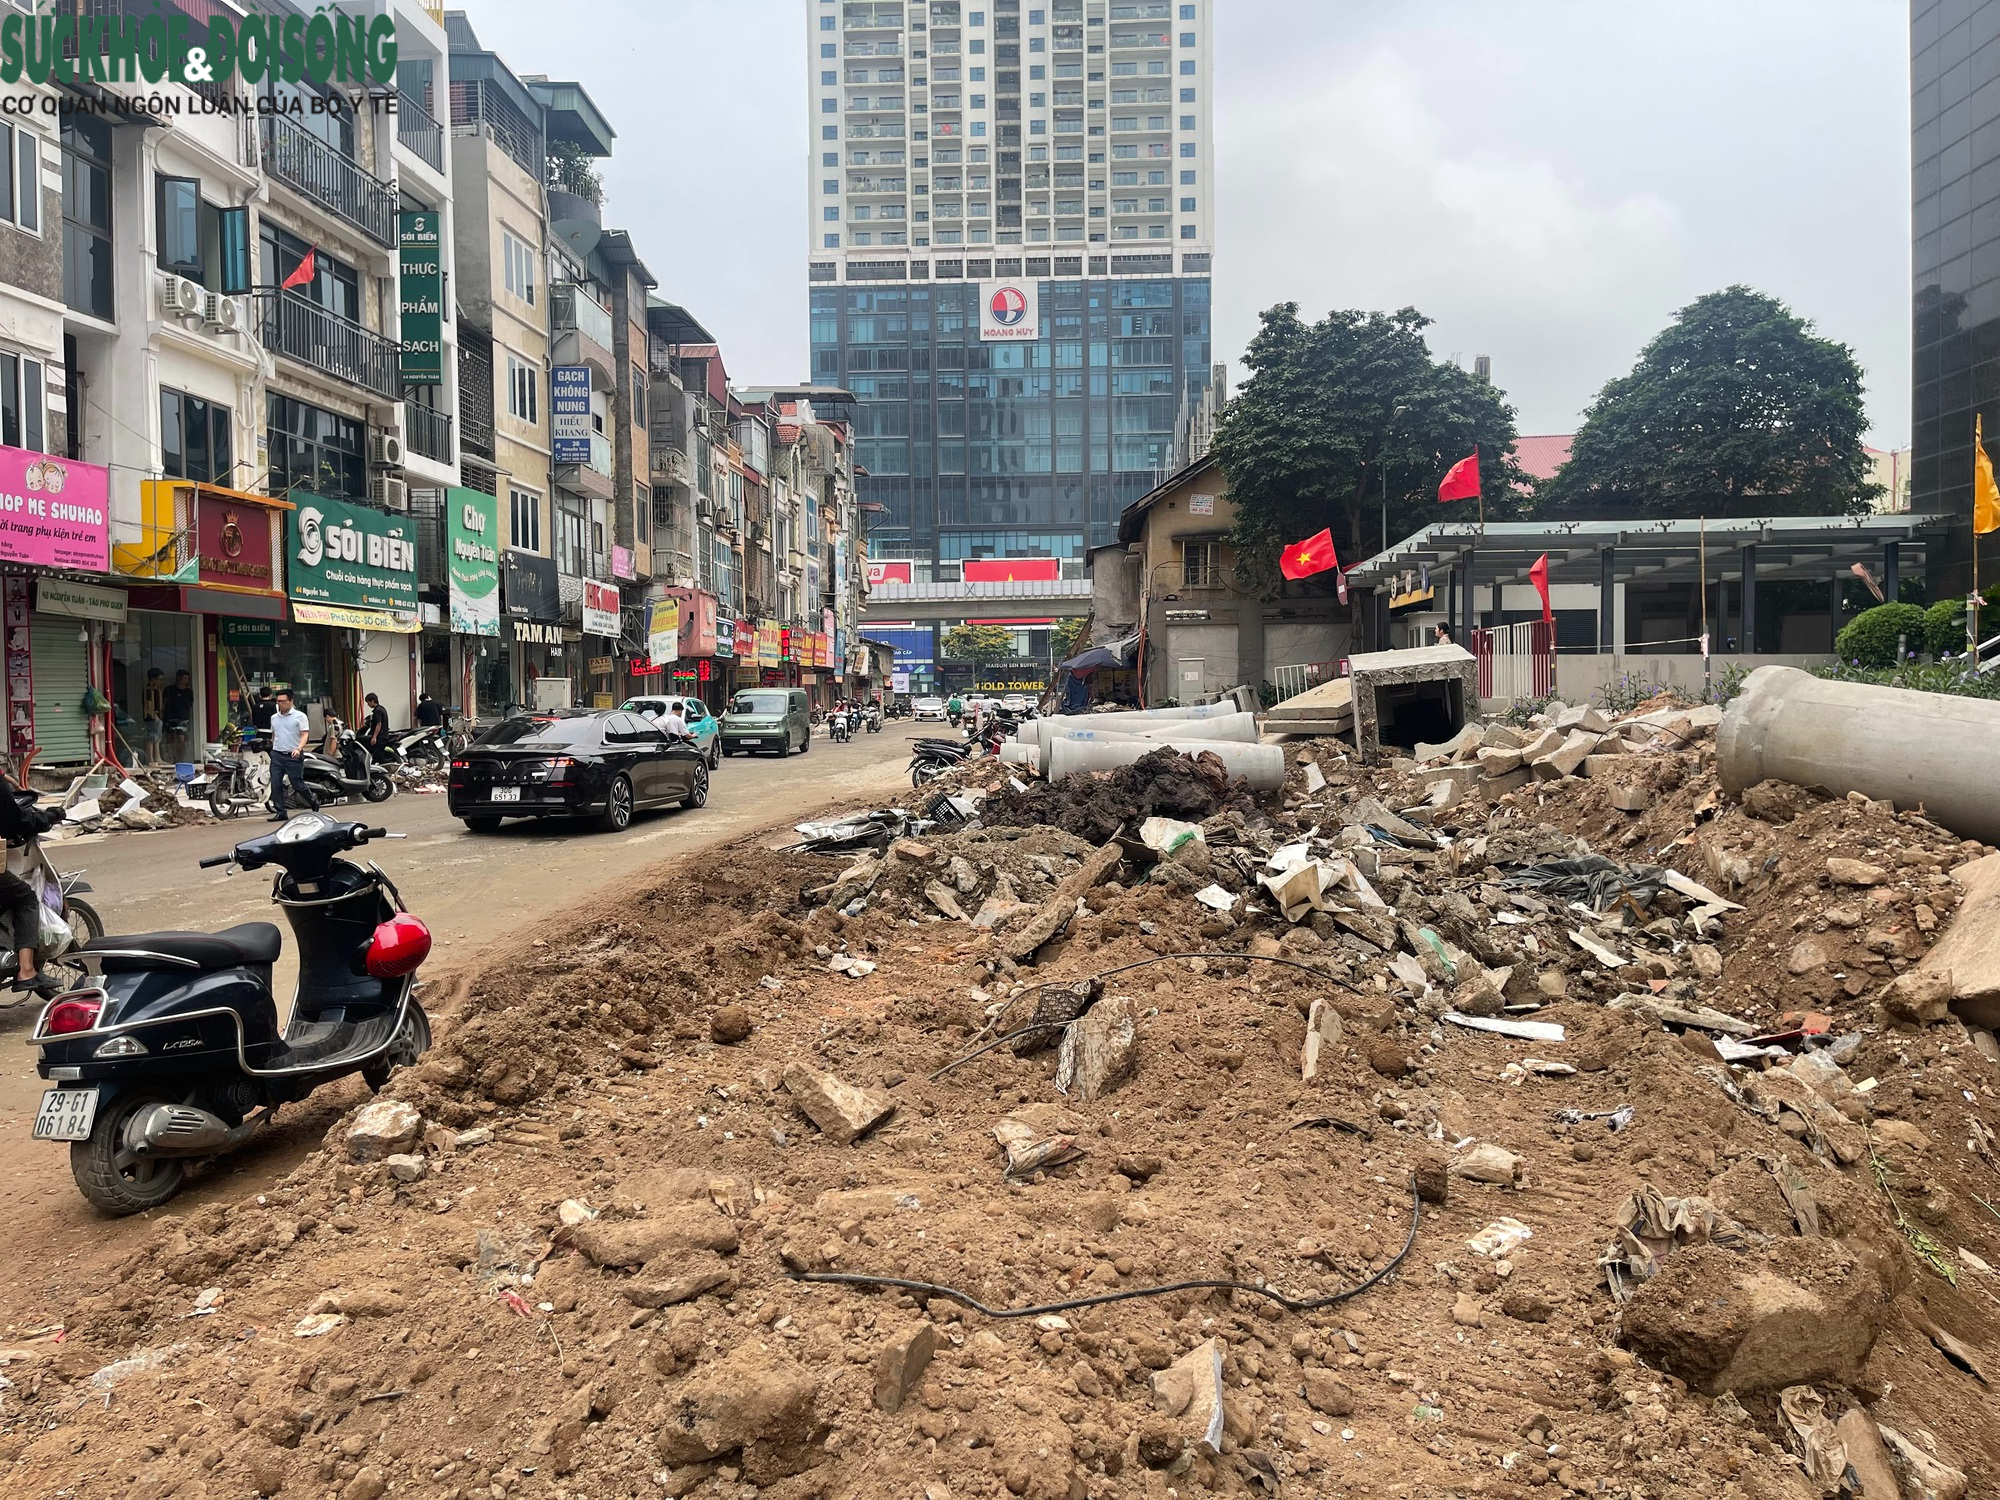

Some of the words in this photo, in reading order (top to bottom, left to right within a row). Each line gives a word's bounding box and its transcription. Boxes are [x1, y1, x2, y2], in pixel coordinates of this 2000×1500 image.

[401, 231, 415, 241] SÓI
[401, 262, 437, 278] THỰC
[401, 295, 438, 314] PHẨM
[984, 328, 1014, 337] HOANG
[1016, 328, 1034, 336] HUY
[402, 341, 439, 355] SẠCH
[557, 370, 585, 384] GẠCH
[554, 384, 588, 398] KHÔNG
[557, 401, 585, 412] NUNG
[560, 415, 583, 426] HIẾU
[555, 429, 588, 437] KHANG
[28, 497, 46, 520] MẸ
[51, 502, 103, 526] SHUHAO
[463, 504, 487, 536] Chợ
[10, 521, 34, 536] trang
[35, 525, 52, 539] phụ
[53, 528, 70, 541] kiện
[71, 530, 84, 542] trẻ
[85, 534, 96, 543] em
[325, 518, 363, 564] SÓI
[367, 527, 414, 573] BIỂN
[454, 537, 480, 561] Nguyễn
[326, 570, 344, 581] Chuỗi
[344, 572, 356, 583] cửa
[356, 575, 371, 587] hàng
[371, 577, 385, 590] thực
[384, 578, 399, 592] phẩm
[400, 582, 413, 593] sạch
[237, 624, 250, 632] SÓI
[514, 616, 543, 643] TÂM
[544, 625, 562, 645] AN
[550, 647, 562, 657] HAIR
[976, 681, 1005, 691] GOLD
[1008, 681, 1045, 691] TOWER
[46, 1092, 89, 1113] 29-G1
